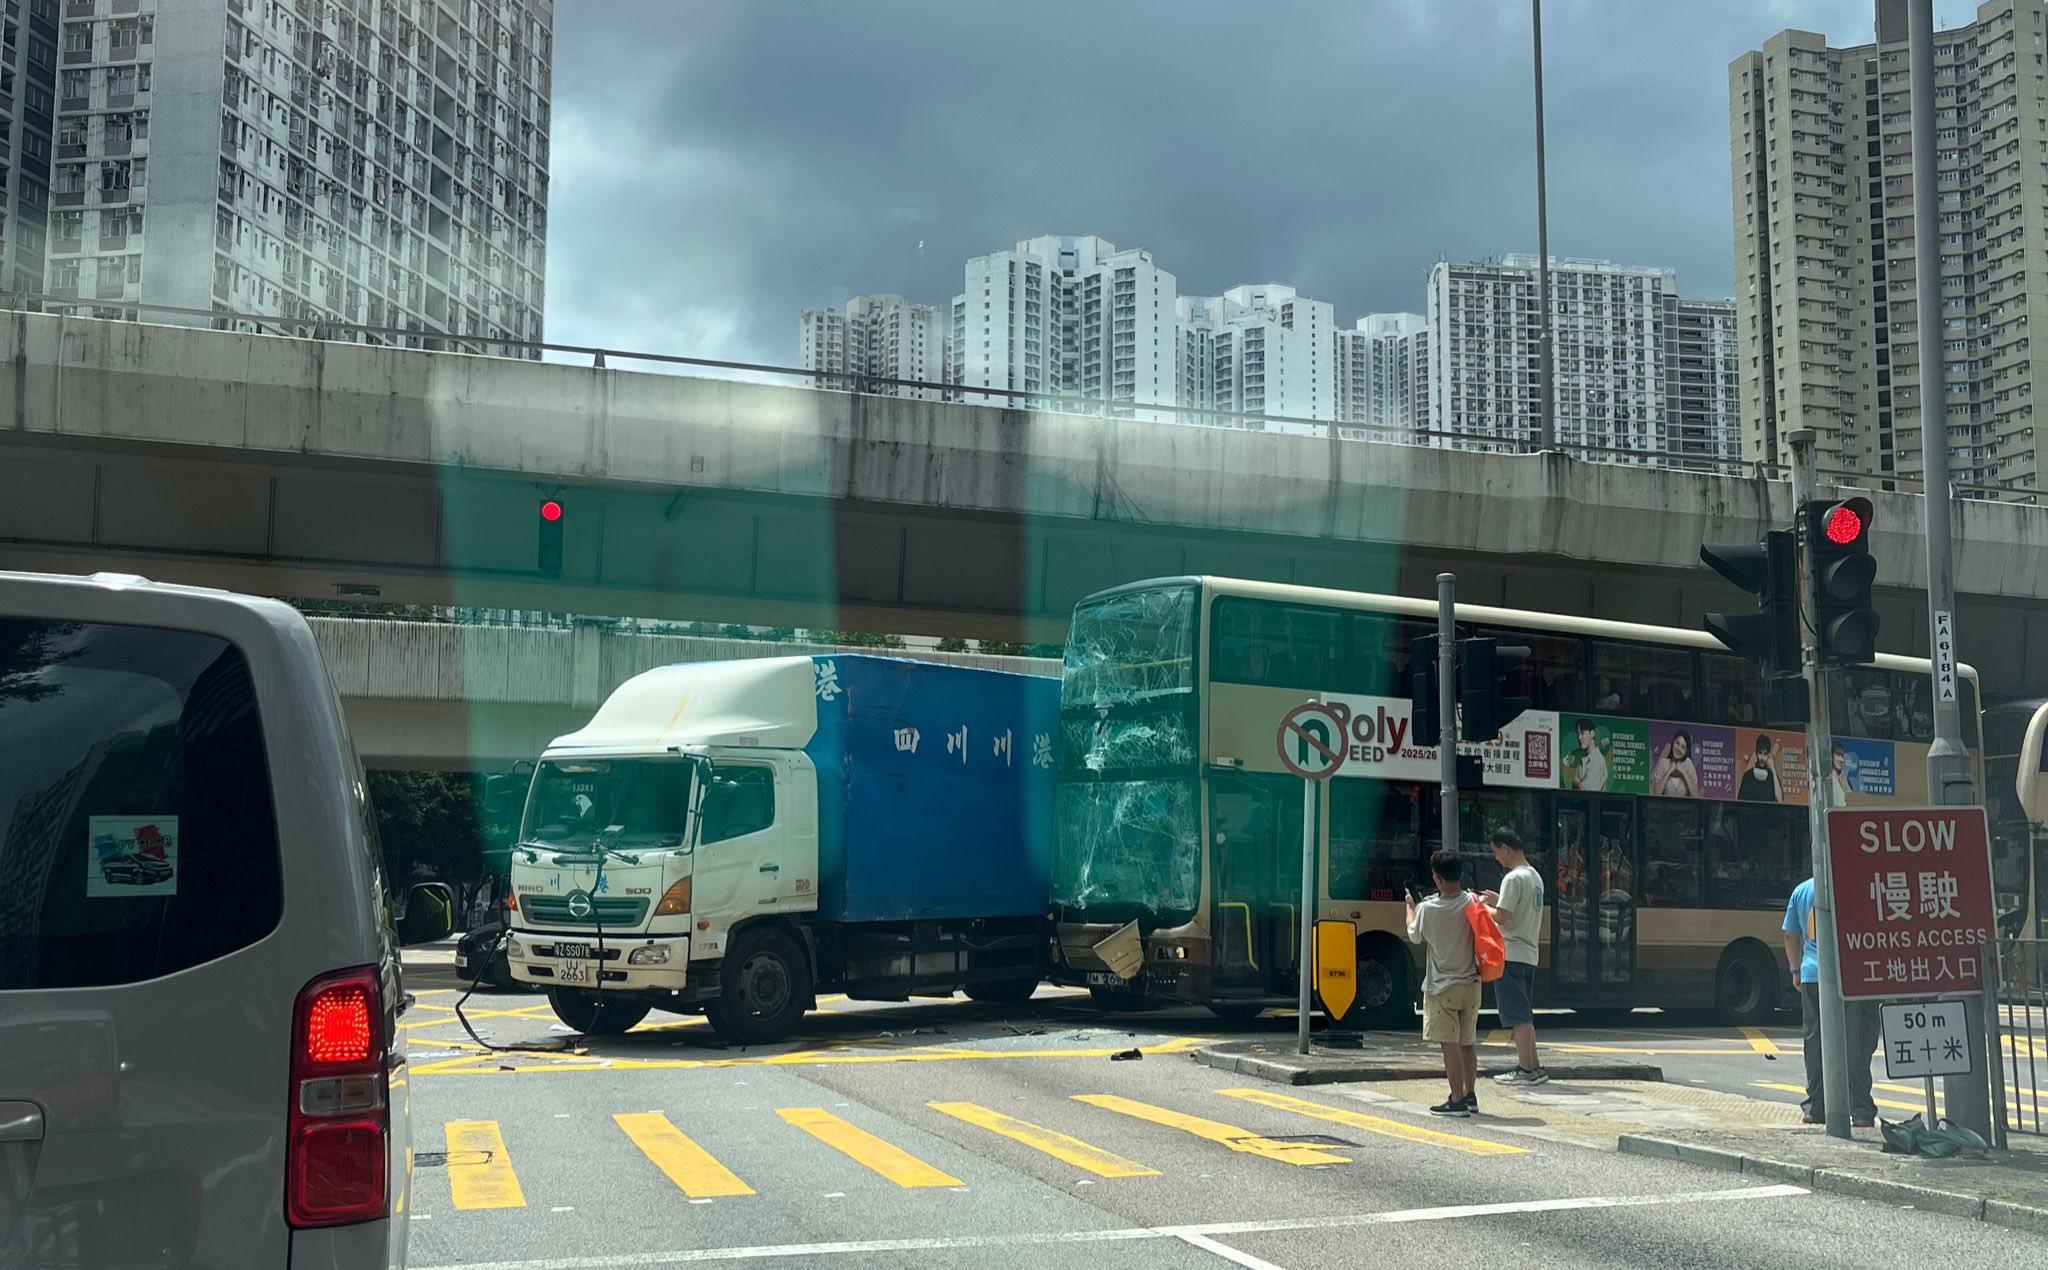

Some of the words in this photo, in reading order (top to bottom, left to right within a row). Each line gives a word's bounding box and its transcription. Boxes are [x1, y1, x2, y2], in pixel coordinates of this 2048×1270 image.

[1401, 748, 1437, 760] 2025/26
[1859, 820, 1956, 853] SLOW
[1870, 871, 1961, 922] 慢駛
[1846, 930, 1911, 950] WORKS
[1917, 928, 1987, 947] ACCESS
[560, 969, 584, 981] 2663
[1863, 956, 1977, 982] 工地出入口
[1904, 1012, 1926, 1029] 50
[1931, 1015, 1946, 1028] m
[1894, 1036, 1963, 1064] 五十米
